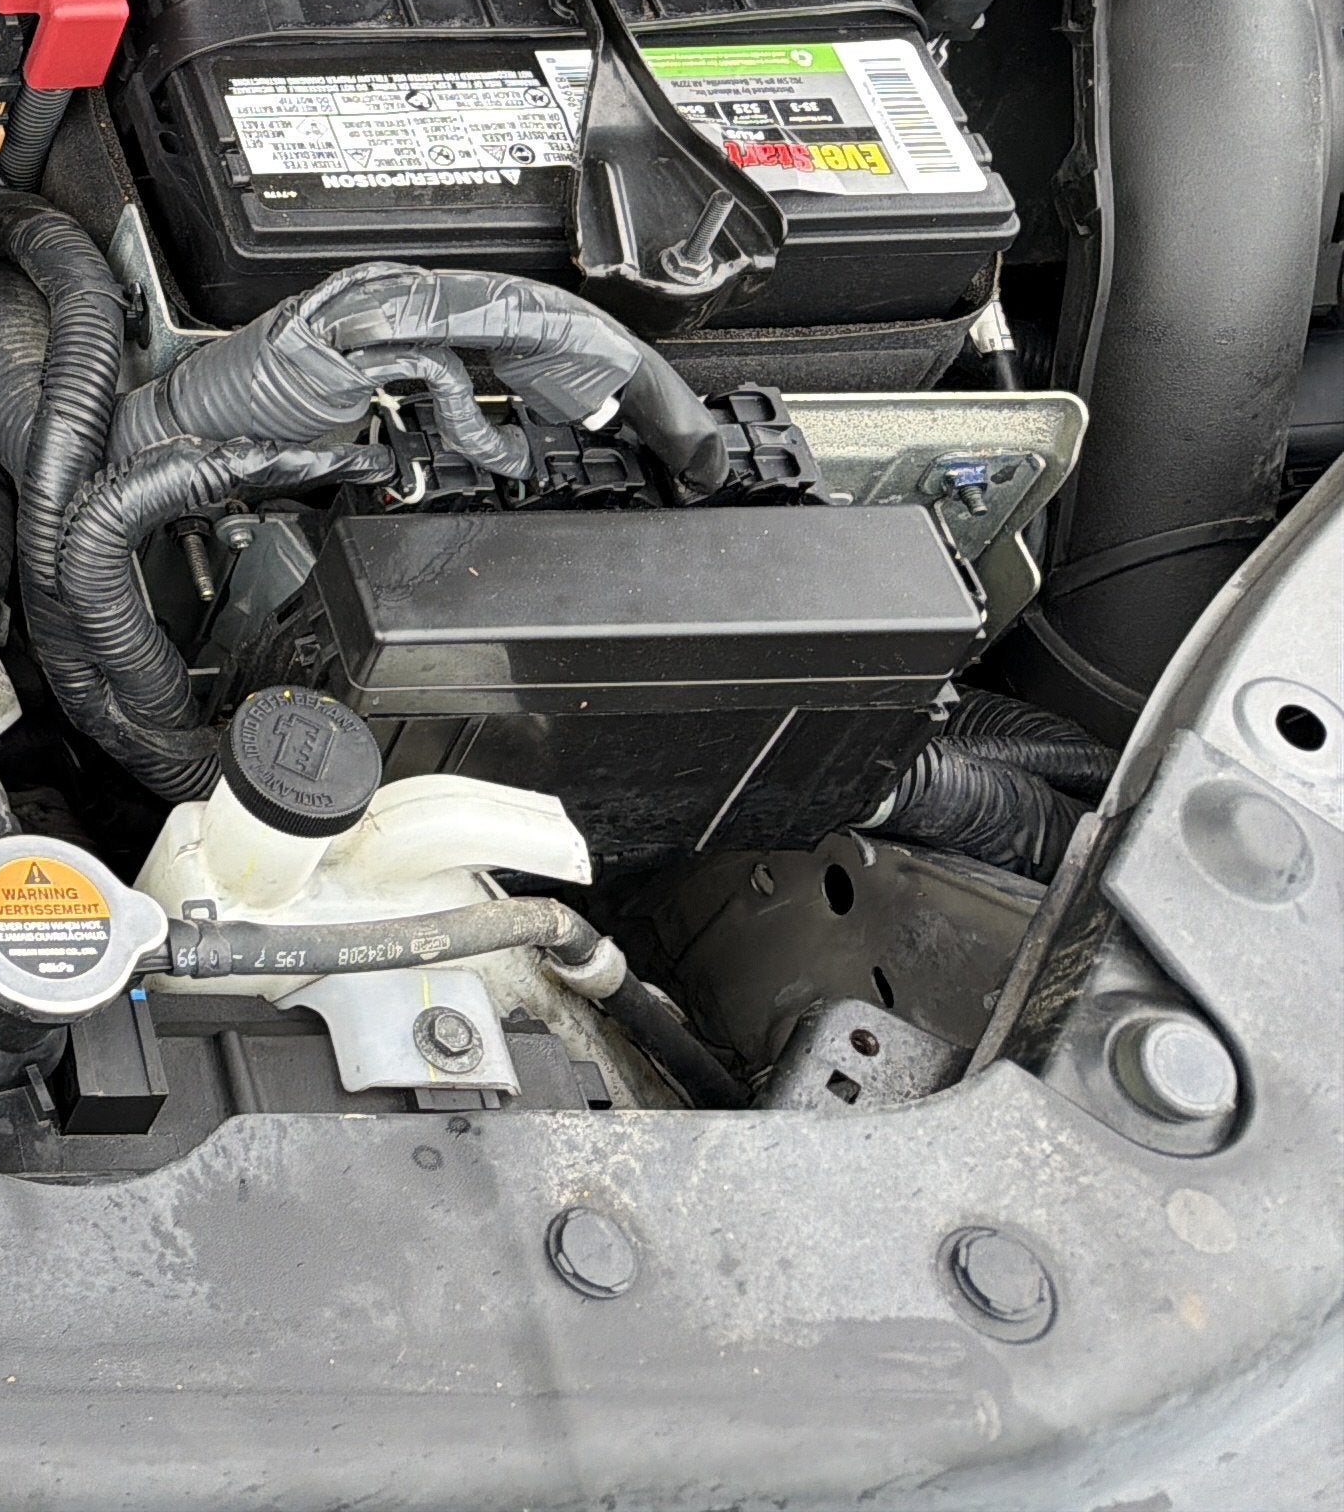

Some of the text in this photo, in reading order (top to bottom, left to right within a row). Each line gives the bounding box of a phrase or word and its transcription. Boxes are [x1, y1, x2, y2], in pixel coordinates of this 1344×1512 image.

[707, 87, 741, 95] Walmart
[741, 86, 751, 94] by
[752, 86, 795, 94] Distributed
[237, 106, 274, 114] BATTERY
[732, 102, 761, 114] 525
[240, 120, 293, 130] HELP FAST
[241, 130, 286, 139] MEDICAL
[481, 131, 566, 142] EXPLOSIVE GASES
[725, 129, 765, 141] PLUS
[245, 139, 264, 148] GET
[307, 141, 334, 151] WITH
[272, 151, 338, 160] IMMEDIATELY
[394, 147, 417, 156] ACID
[373, 157, 421, 168] SULFURIC
[723, 140, 895, 177] EverStart
[283, 160, 342, 170] FLUSH EYES
[321, 170, 503, 188] DANGER/POISON
[1, 887, 80, 901] WARNING
[23, 921, 50, 931] OPEN
[50, 921, 80, 931] WHEN
[80, 920, 104, 930] HOT.
[74, 931, 108, 941] CHAUD.
[275, 950, 306, 968] 195
